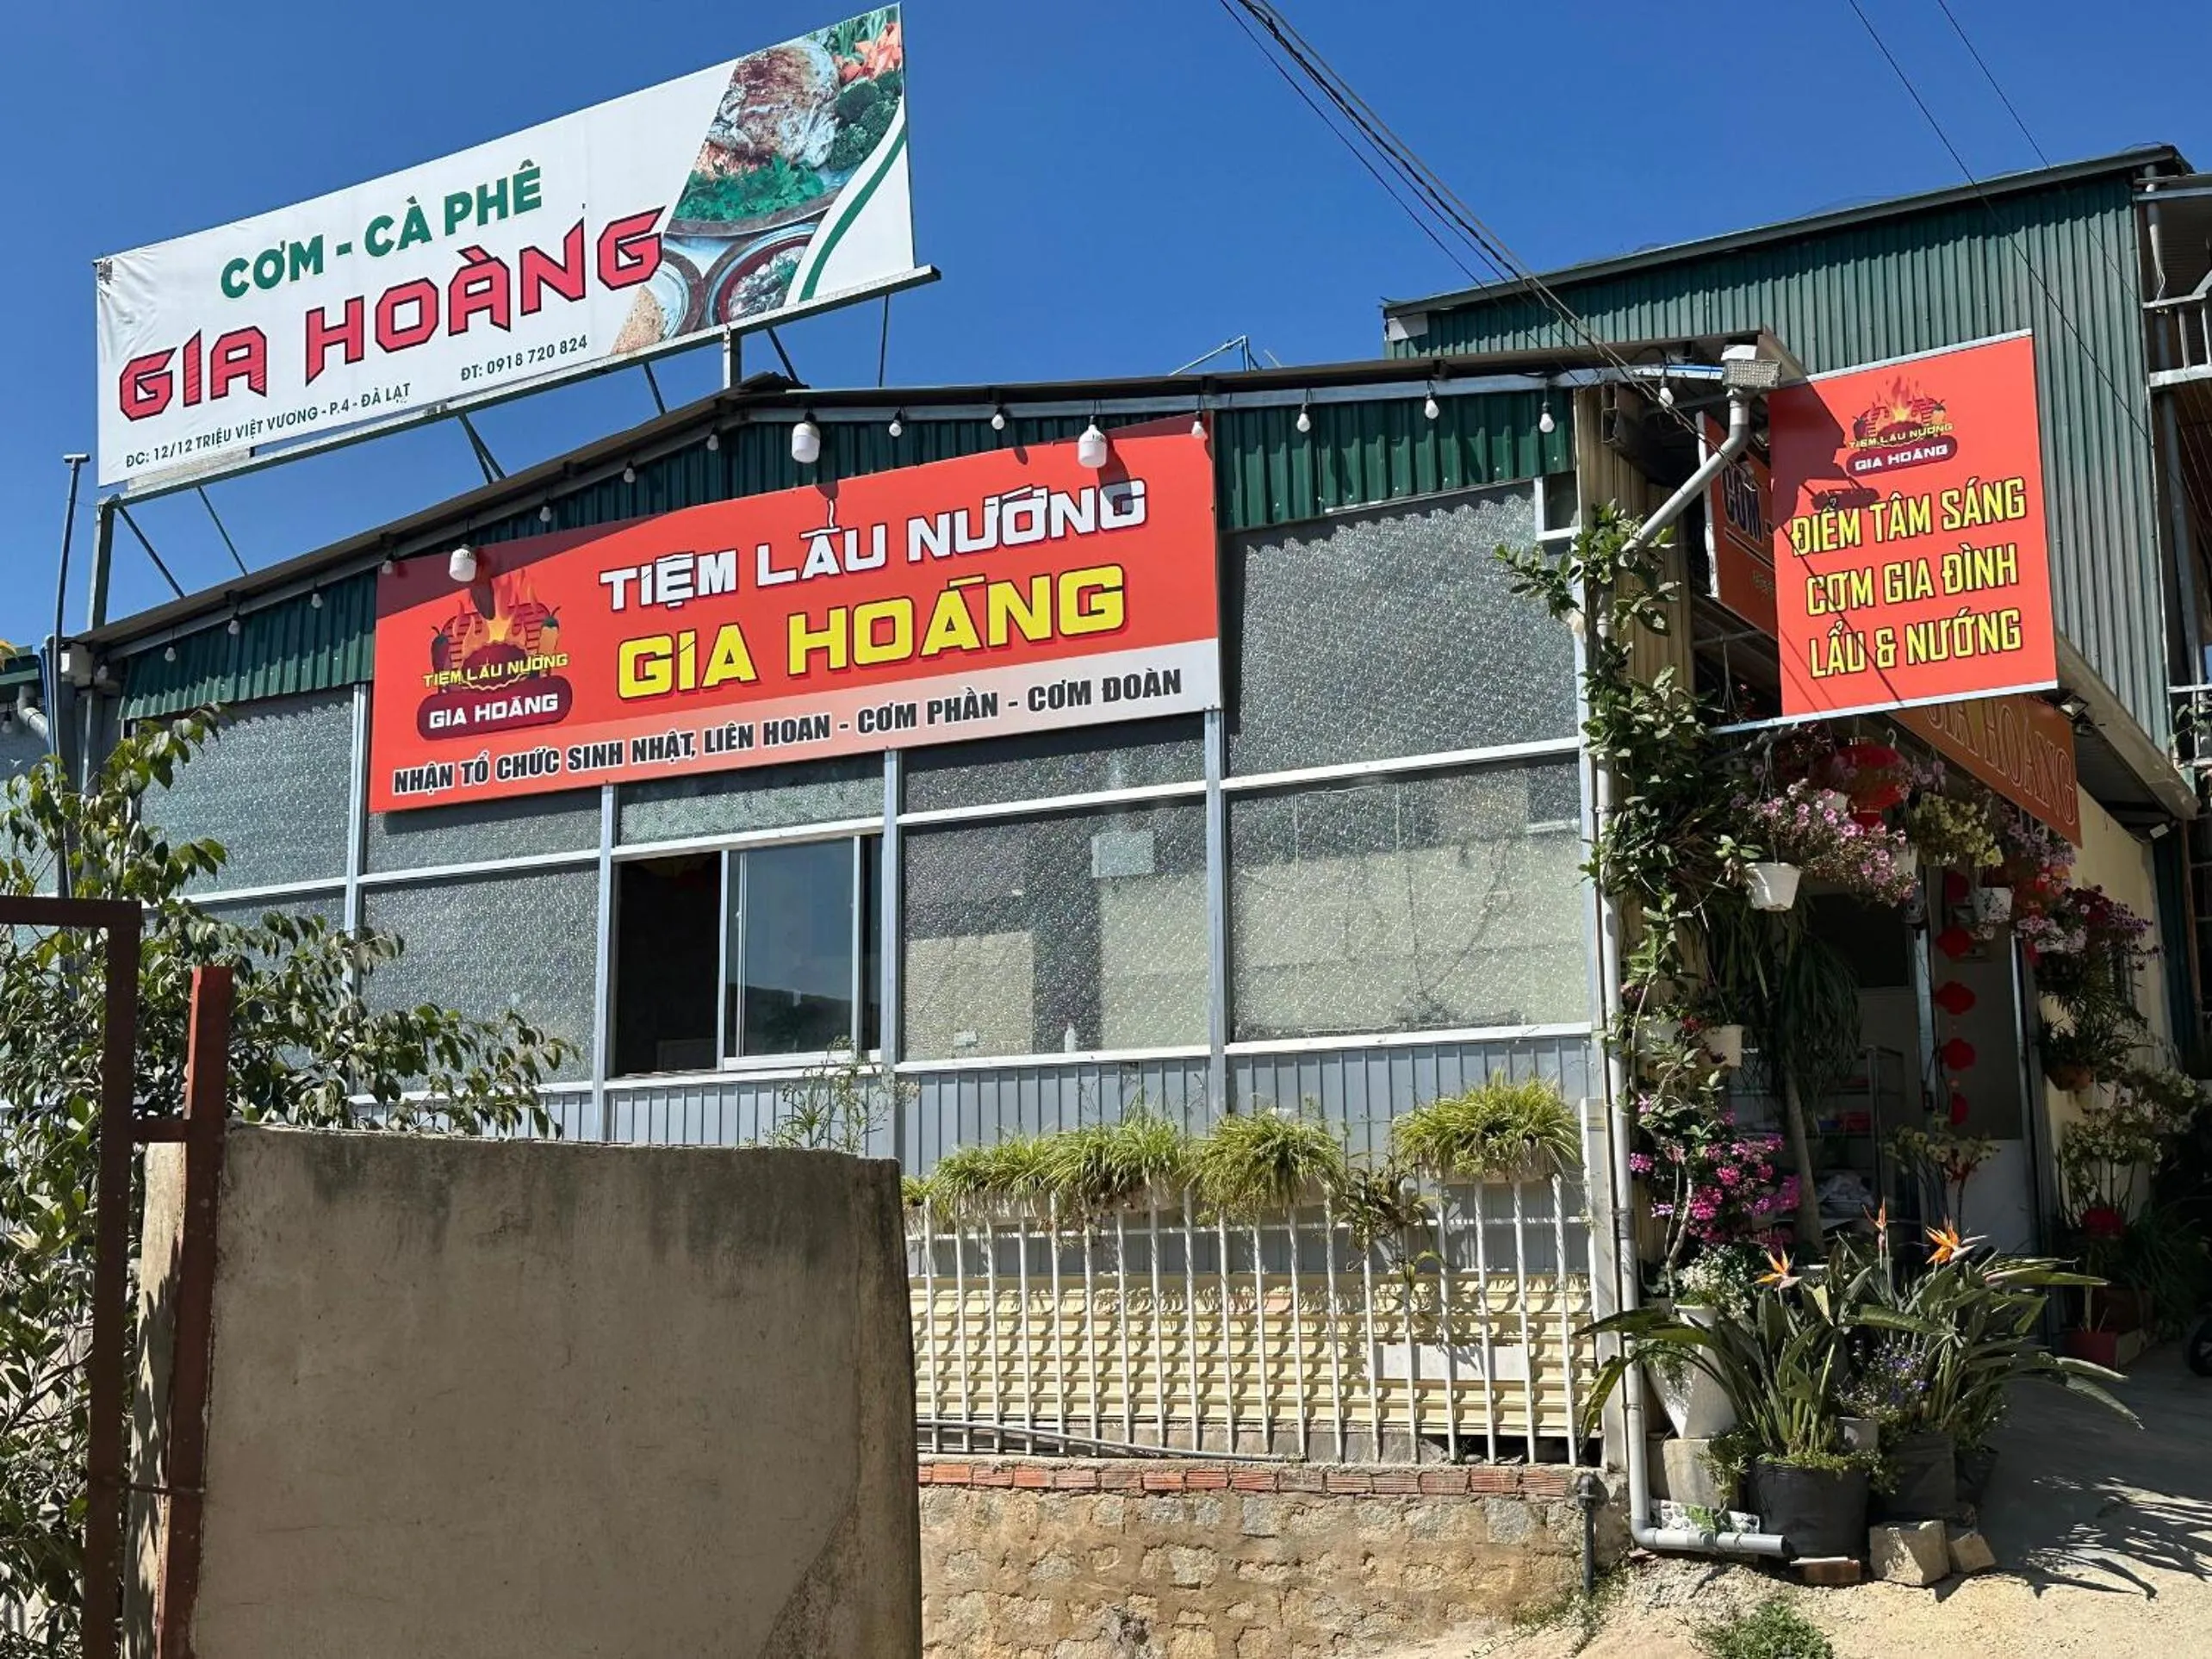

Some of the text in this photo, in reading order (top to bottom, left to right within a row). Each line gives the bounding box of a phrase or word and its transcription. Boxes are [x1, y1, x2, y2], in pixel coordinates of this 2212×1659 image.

[221, 234, 323, 298] CƠM
[364, 196, 432, 257] CÀ
[444, 158, 542, 237] PHÊ
[119, 206, 666, 422] GIA HOÀNG
[461, 334, 587, 381] ĐT: 0918 720 824
[127, 451, 150, 468] ĐC:
[154, 438, 193, 460] 12/12
[196, 427, 232, 448] TRIỆU
[235, 419, 263, 439] VIỆT
[330, 398, 350, 415] P.4
[361, 388, 381, 407] ĐÀ
[386, 382, 411, 403] LẠT
[1855, 457, 1883, 471] GIA
[599, 548, 738, 612] TIỆM
[907, 478, 1146, 563] NƯỚNG
[1869, 491, 1932, 544] TÂM
[1941, 476, 2027, 531] SÁNG
[1805, 566, 1875, 617] CƠM
[1883, 558, 1936, 605] GIA
[1942, 542, 2019, 596] ĐÌNH
[617, 622, 758, 700] GIA
[1810, 606, 2023, 679] LẨU & NƯỚNG
[392, 761, 454, 796] NHẬN
[459, 750, 490, 785] TỔ
[495, 746, 560, 781] CHỨC
[566, 738, 624, 772] SINH
[631, 730, 697, 764] NHẬT,
[703, 722, 754, 755] LIÊN
[762, 713, 831, 746] HOAN
[856, 704, 918, 736] CƠM
[926, 686, 999, 726] PHẦN
[1027, 678, 1093, 711] CƠM
[1101, 668, 1183, 702] ĐOÀN
[428, 707, 467, 730] GIA
